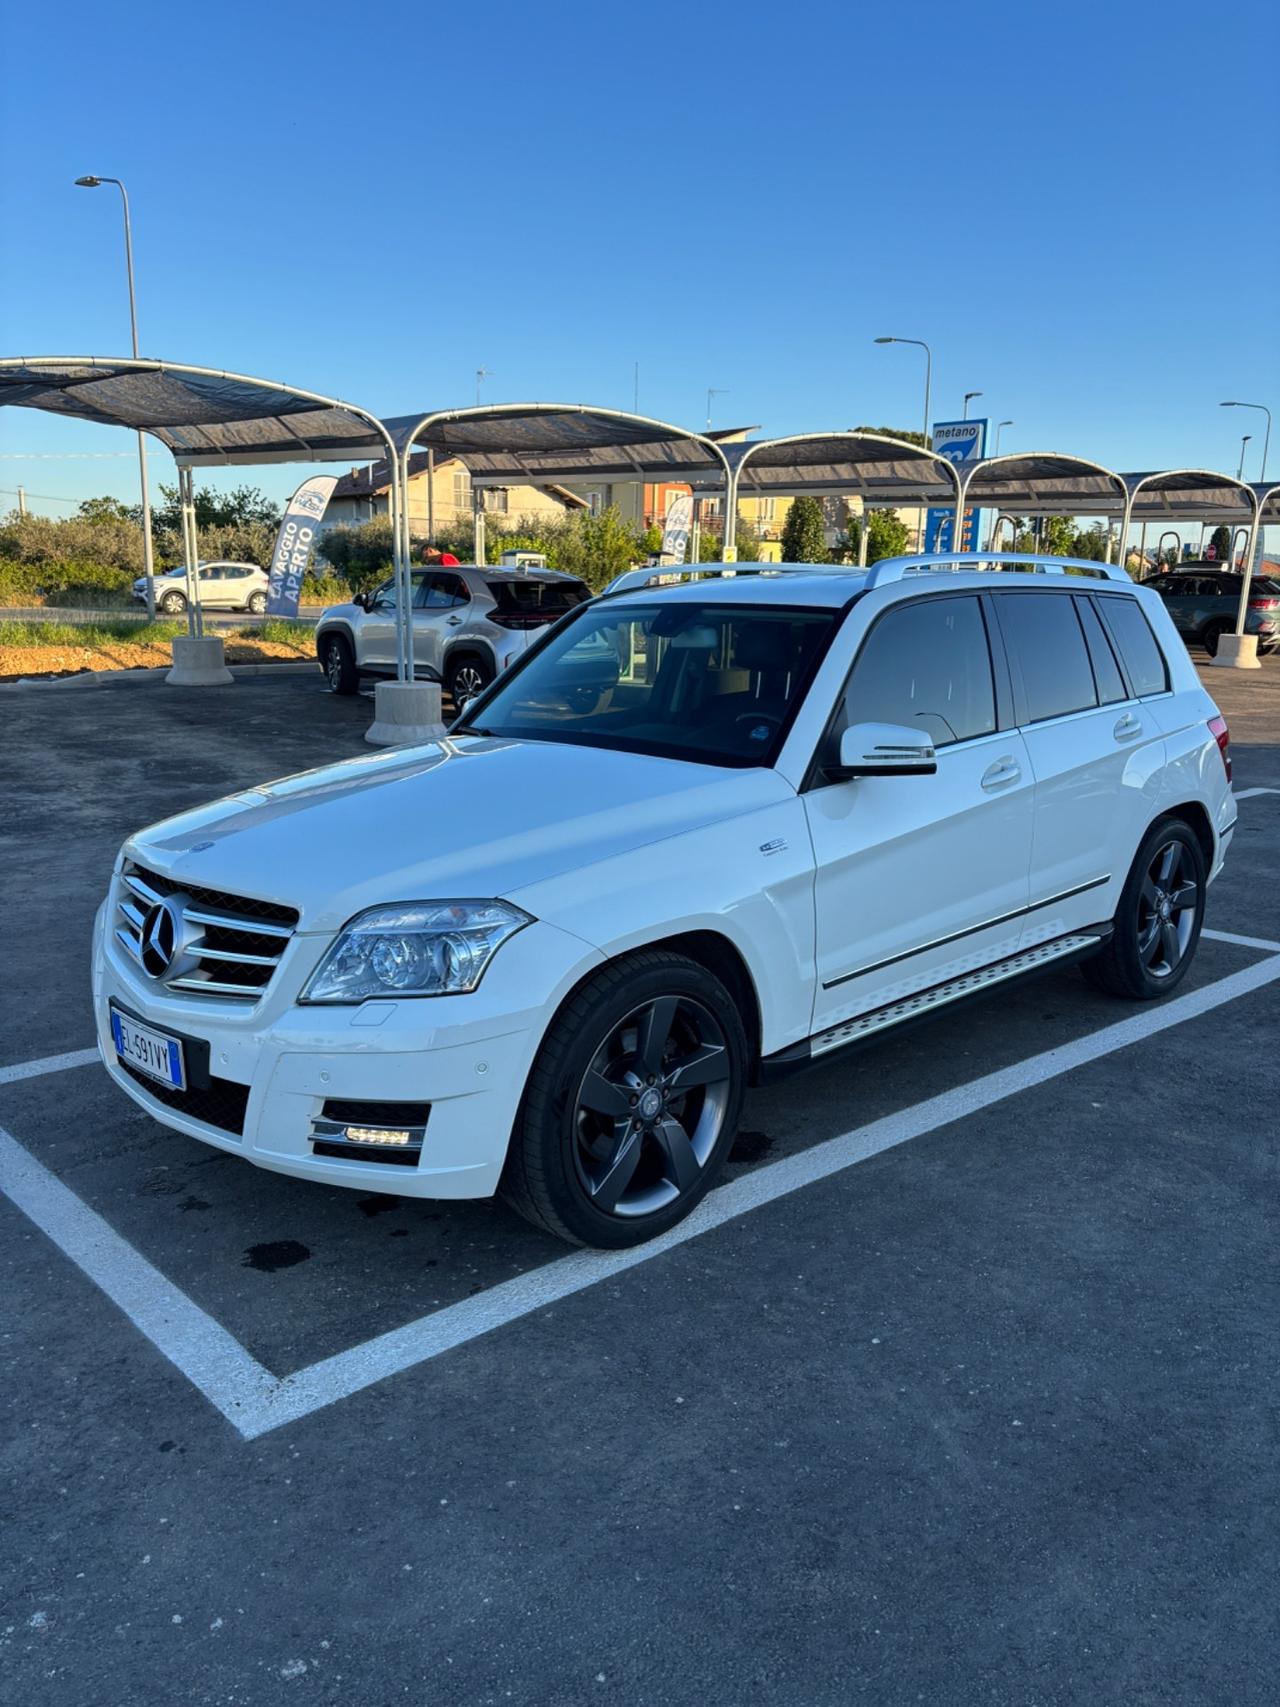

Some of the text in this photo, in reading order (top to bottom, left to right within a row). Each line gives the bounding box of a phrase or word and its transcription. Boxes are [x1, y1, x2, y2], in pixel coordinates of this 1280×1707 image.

[935, 426, 976, 438] metano
[270, 522, 297, 599] LAVAGGIO
[284, 527, 313, 603] APERTO
